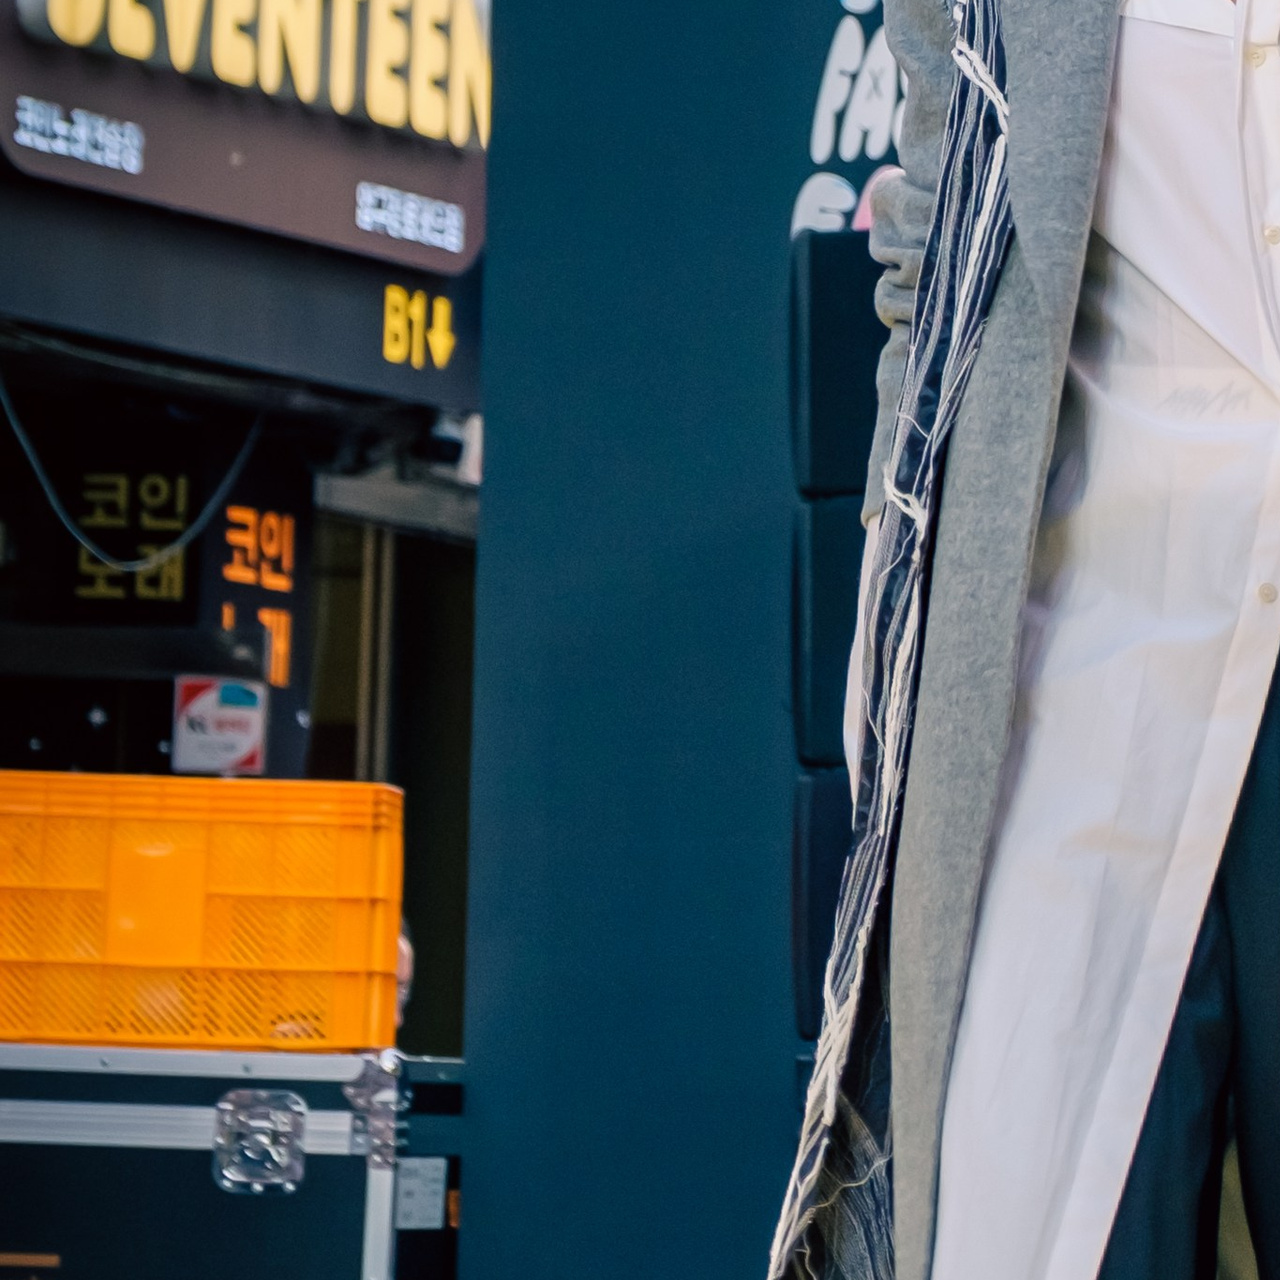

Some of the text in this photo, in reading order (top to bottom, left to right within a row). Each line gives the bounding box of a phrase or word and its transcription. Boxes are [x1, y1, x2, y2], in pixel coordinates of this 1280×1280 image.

[383, 285, 426, 370] B1
[80, 474, 188, 529] 코인
[76, 543, 185, 601] 노래
[222, 505, 294, 593] 코인
